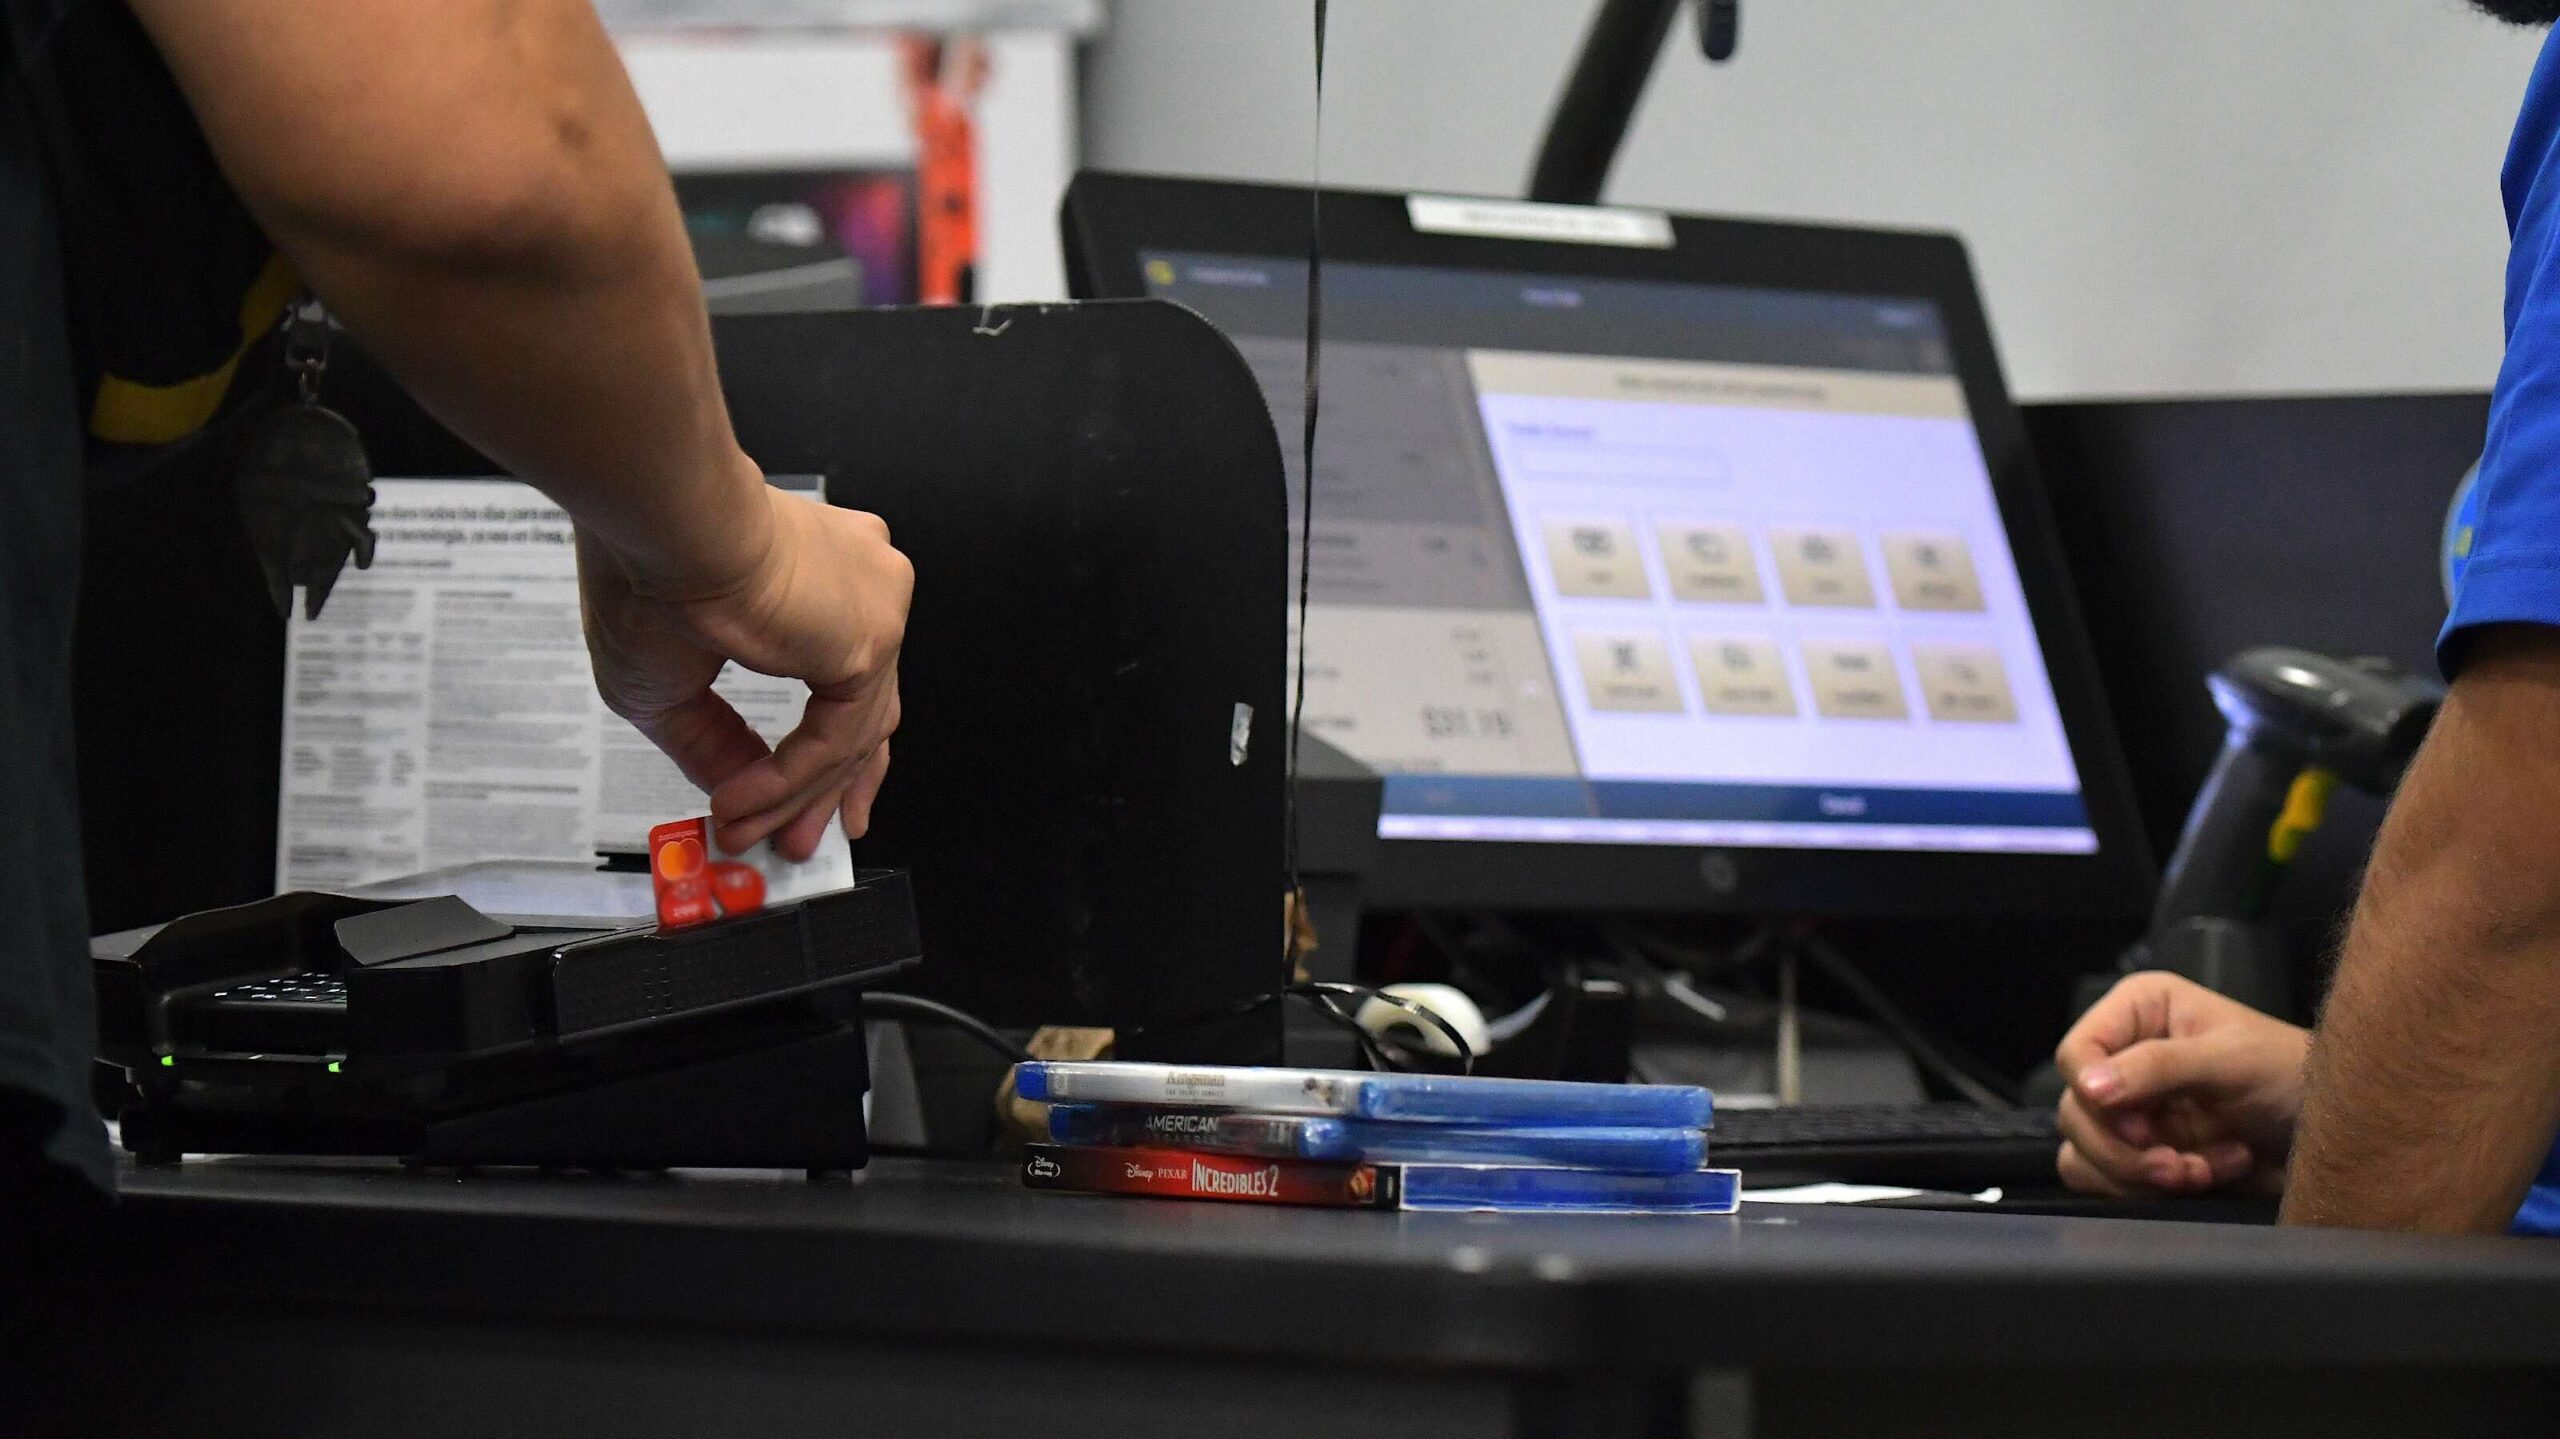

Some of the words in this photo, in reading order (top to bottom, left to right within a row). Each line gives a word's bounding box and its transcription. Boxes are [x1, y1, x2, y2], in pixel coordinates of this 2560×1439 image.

[1145, 1115, 1219, 1133] AMERICAN
[1125, 1163, 1153, 1182] Disney
[1158, 1168, 1187, 1179] PIXAR
[1191, 1158, 1267, 1195] INCREDIBLES
[1268, 1165, 1279, 1196] 2
